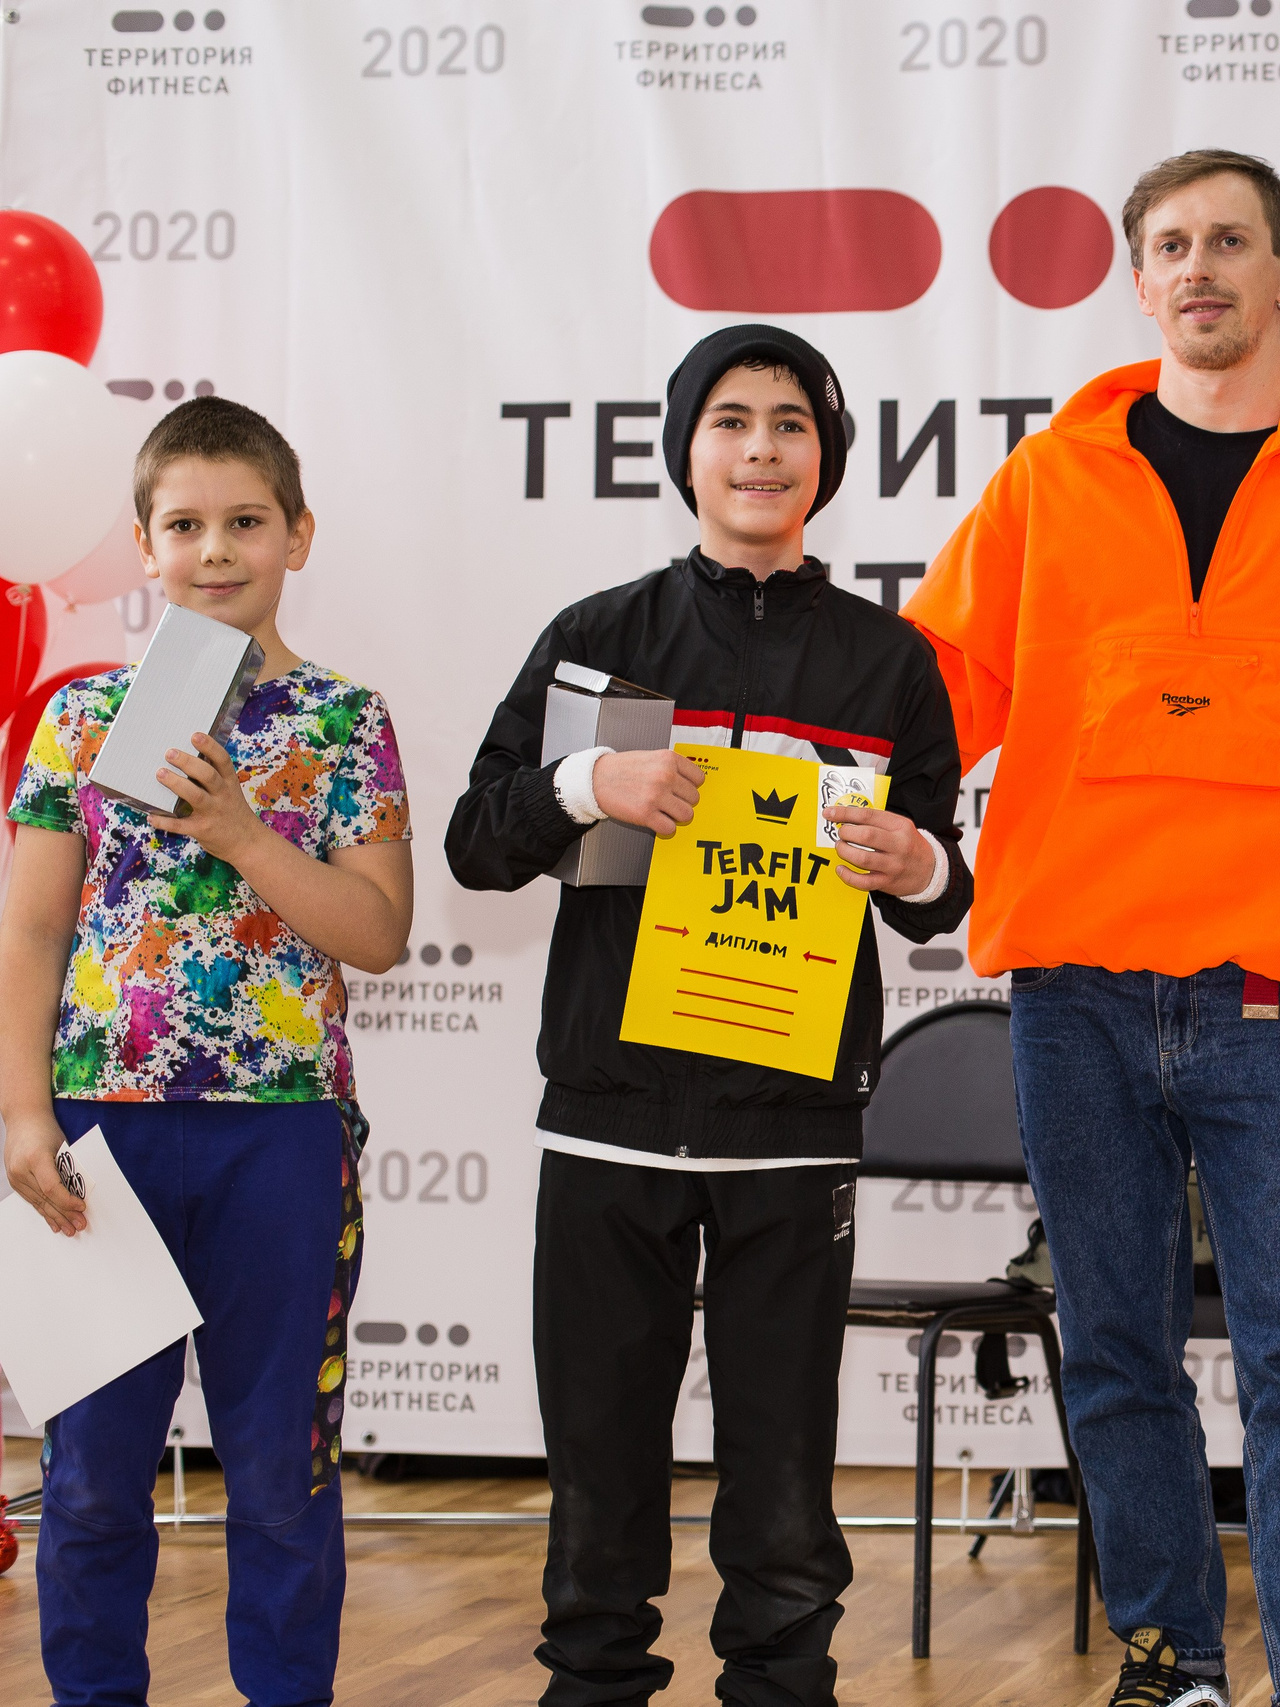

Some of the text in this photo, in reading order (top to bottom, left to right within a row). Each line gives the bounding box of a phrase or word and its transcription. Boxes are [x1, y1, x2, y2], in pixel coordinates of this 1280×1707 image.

[361, 22, 506, 78] 2020
[614, 40, 787, 62] ТЕРРИТОРИЯ
[899, 15, 1048, 72] 2020
[83, 46, 253, 67] ТЕРРИТОРИЯ
[106, 76, 230, 95] ФИТНЕСА
[636, 69, 763, 91] ФИТНЕСА
[93, 209, 236, 262] 2020
[1161, 692, 1210, 706] Reebok
[696, 840, 831, 885] TERFIT
[710, 878, 798, 922] JAM
[705, 931, 787, 958] ДИПЛОМ
[348, 981, 503, 1002] ЕРРИТОРИЯ
[353, 1011, 478, 1032] ФИТНЕСА
[346, 1359, 499, 1383] ЕРРИТОРИЯ
[350, 1390, 476, 1412] ФИТНЕСА
